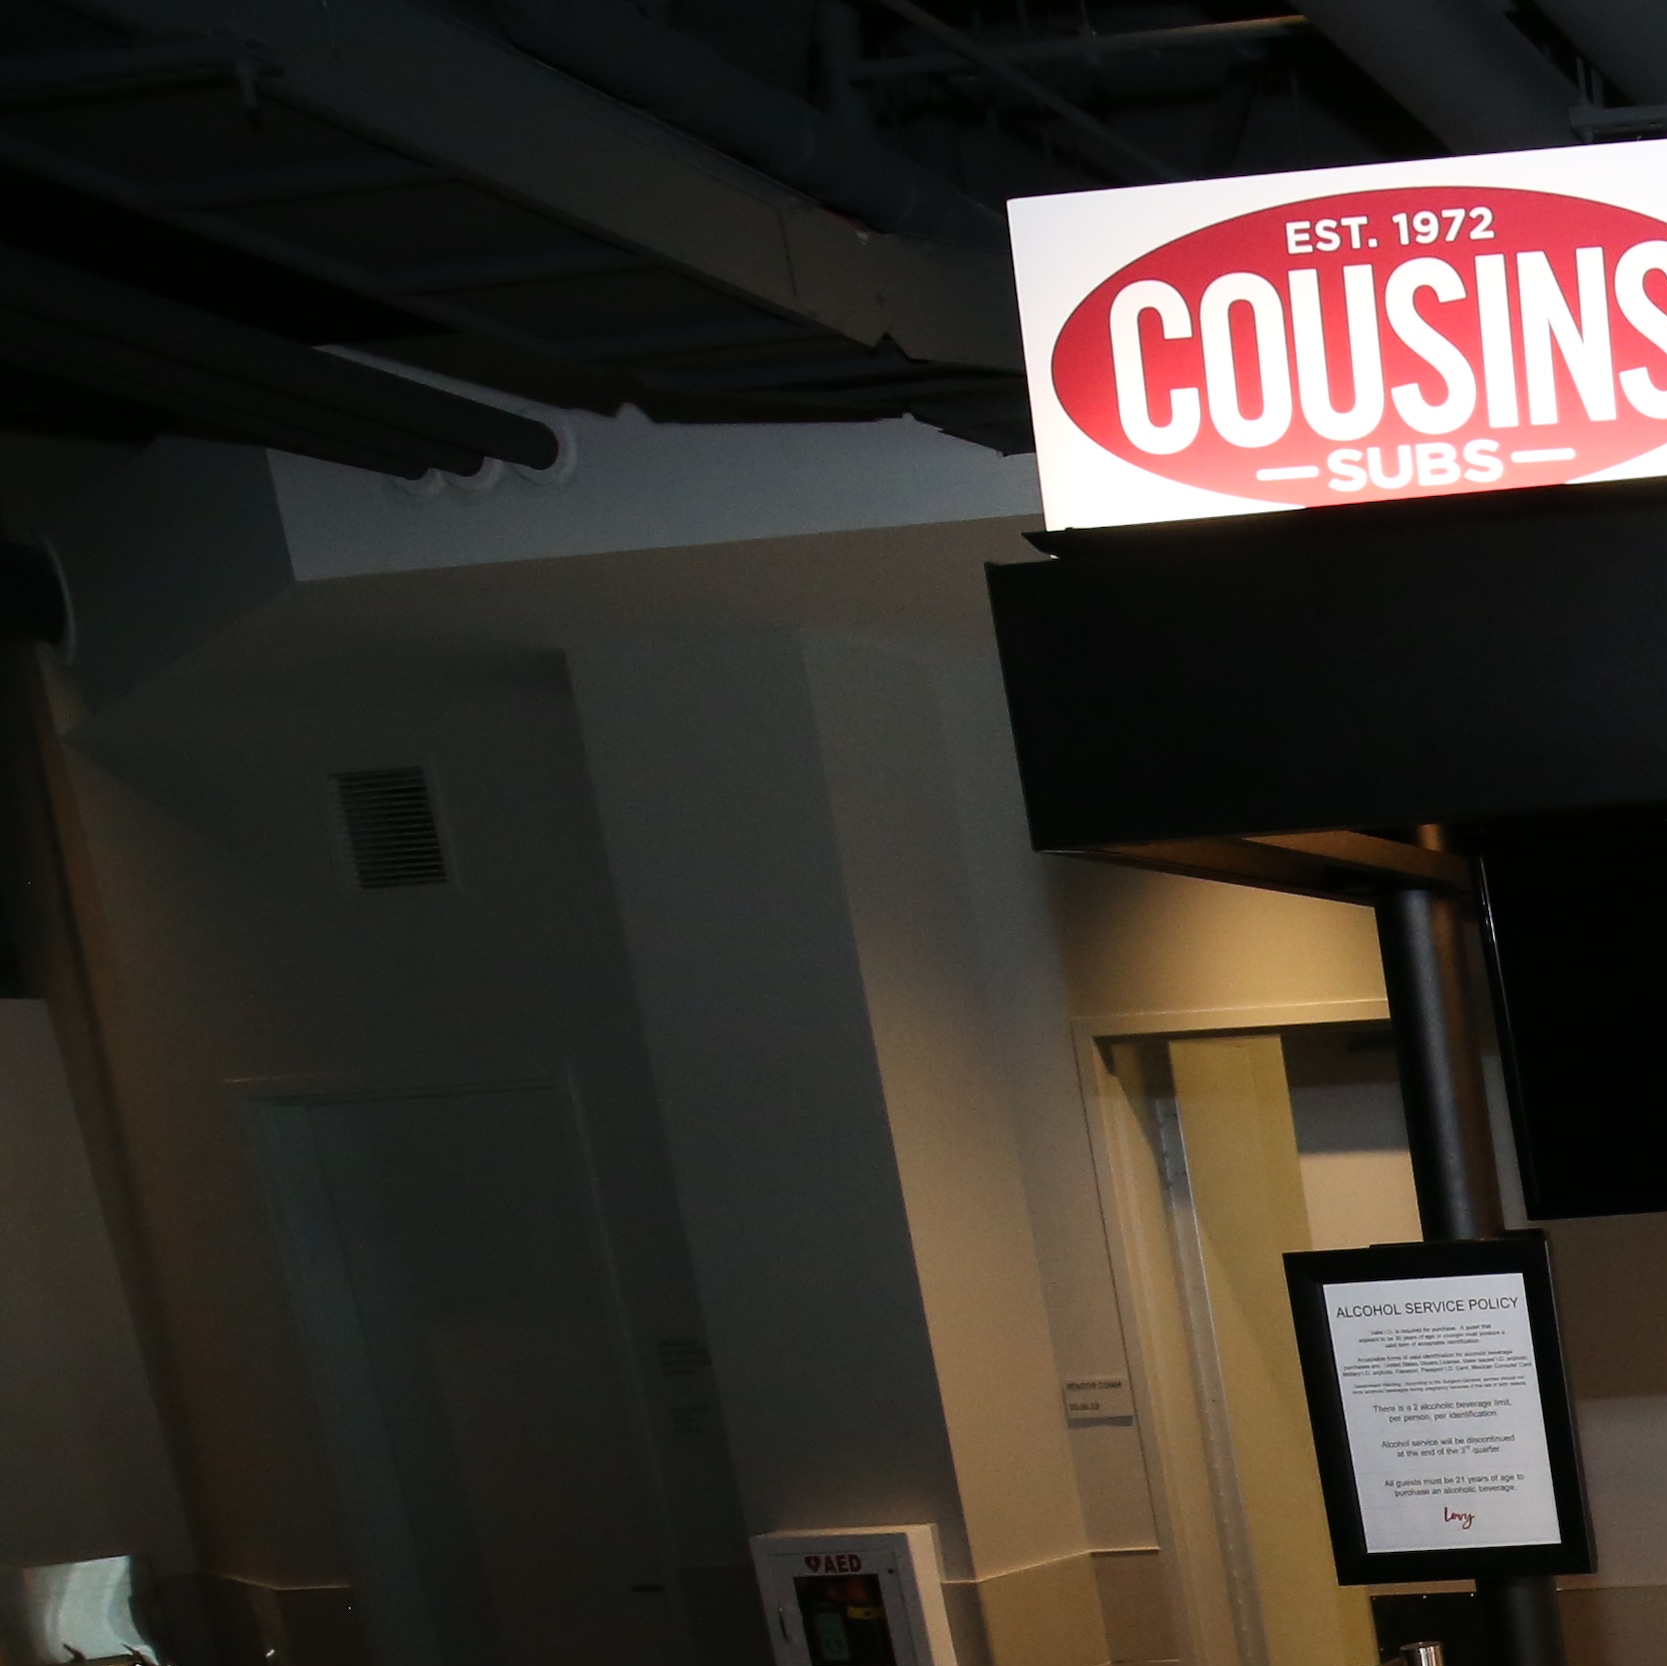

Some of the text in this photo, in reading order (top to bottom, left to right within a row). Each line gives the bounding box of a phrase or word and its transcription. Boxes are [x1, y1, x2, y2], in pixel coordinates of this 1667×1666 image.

[1285, 206, 1496, 256] EST. 1972
[1327, 438, 1506, 494] SUBS
[1336, 1297, 1519, 1318] ALCOHOL SERVICE POLICY
[1372, 1405, 1396, 1413] There
[1420, 1402, 1454, 1411] alcoholic
[1456, 1400, 1492, 1410] beverage
[1381, 1440, 1410, 1448] Alcohol
[1467, 1434, 1516, 1443] discontinued
[1423, 1478, 1442, 1486] must
[1395, 1488, 1430, 1498] purchase
[1444, 1485, 1477, 1494] alcoholic
[824, 1554, 863, 1574] AED
